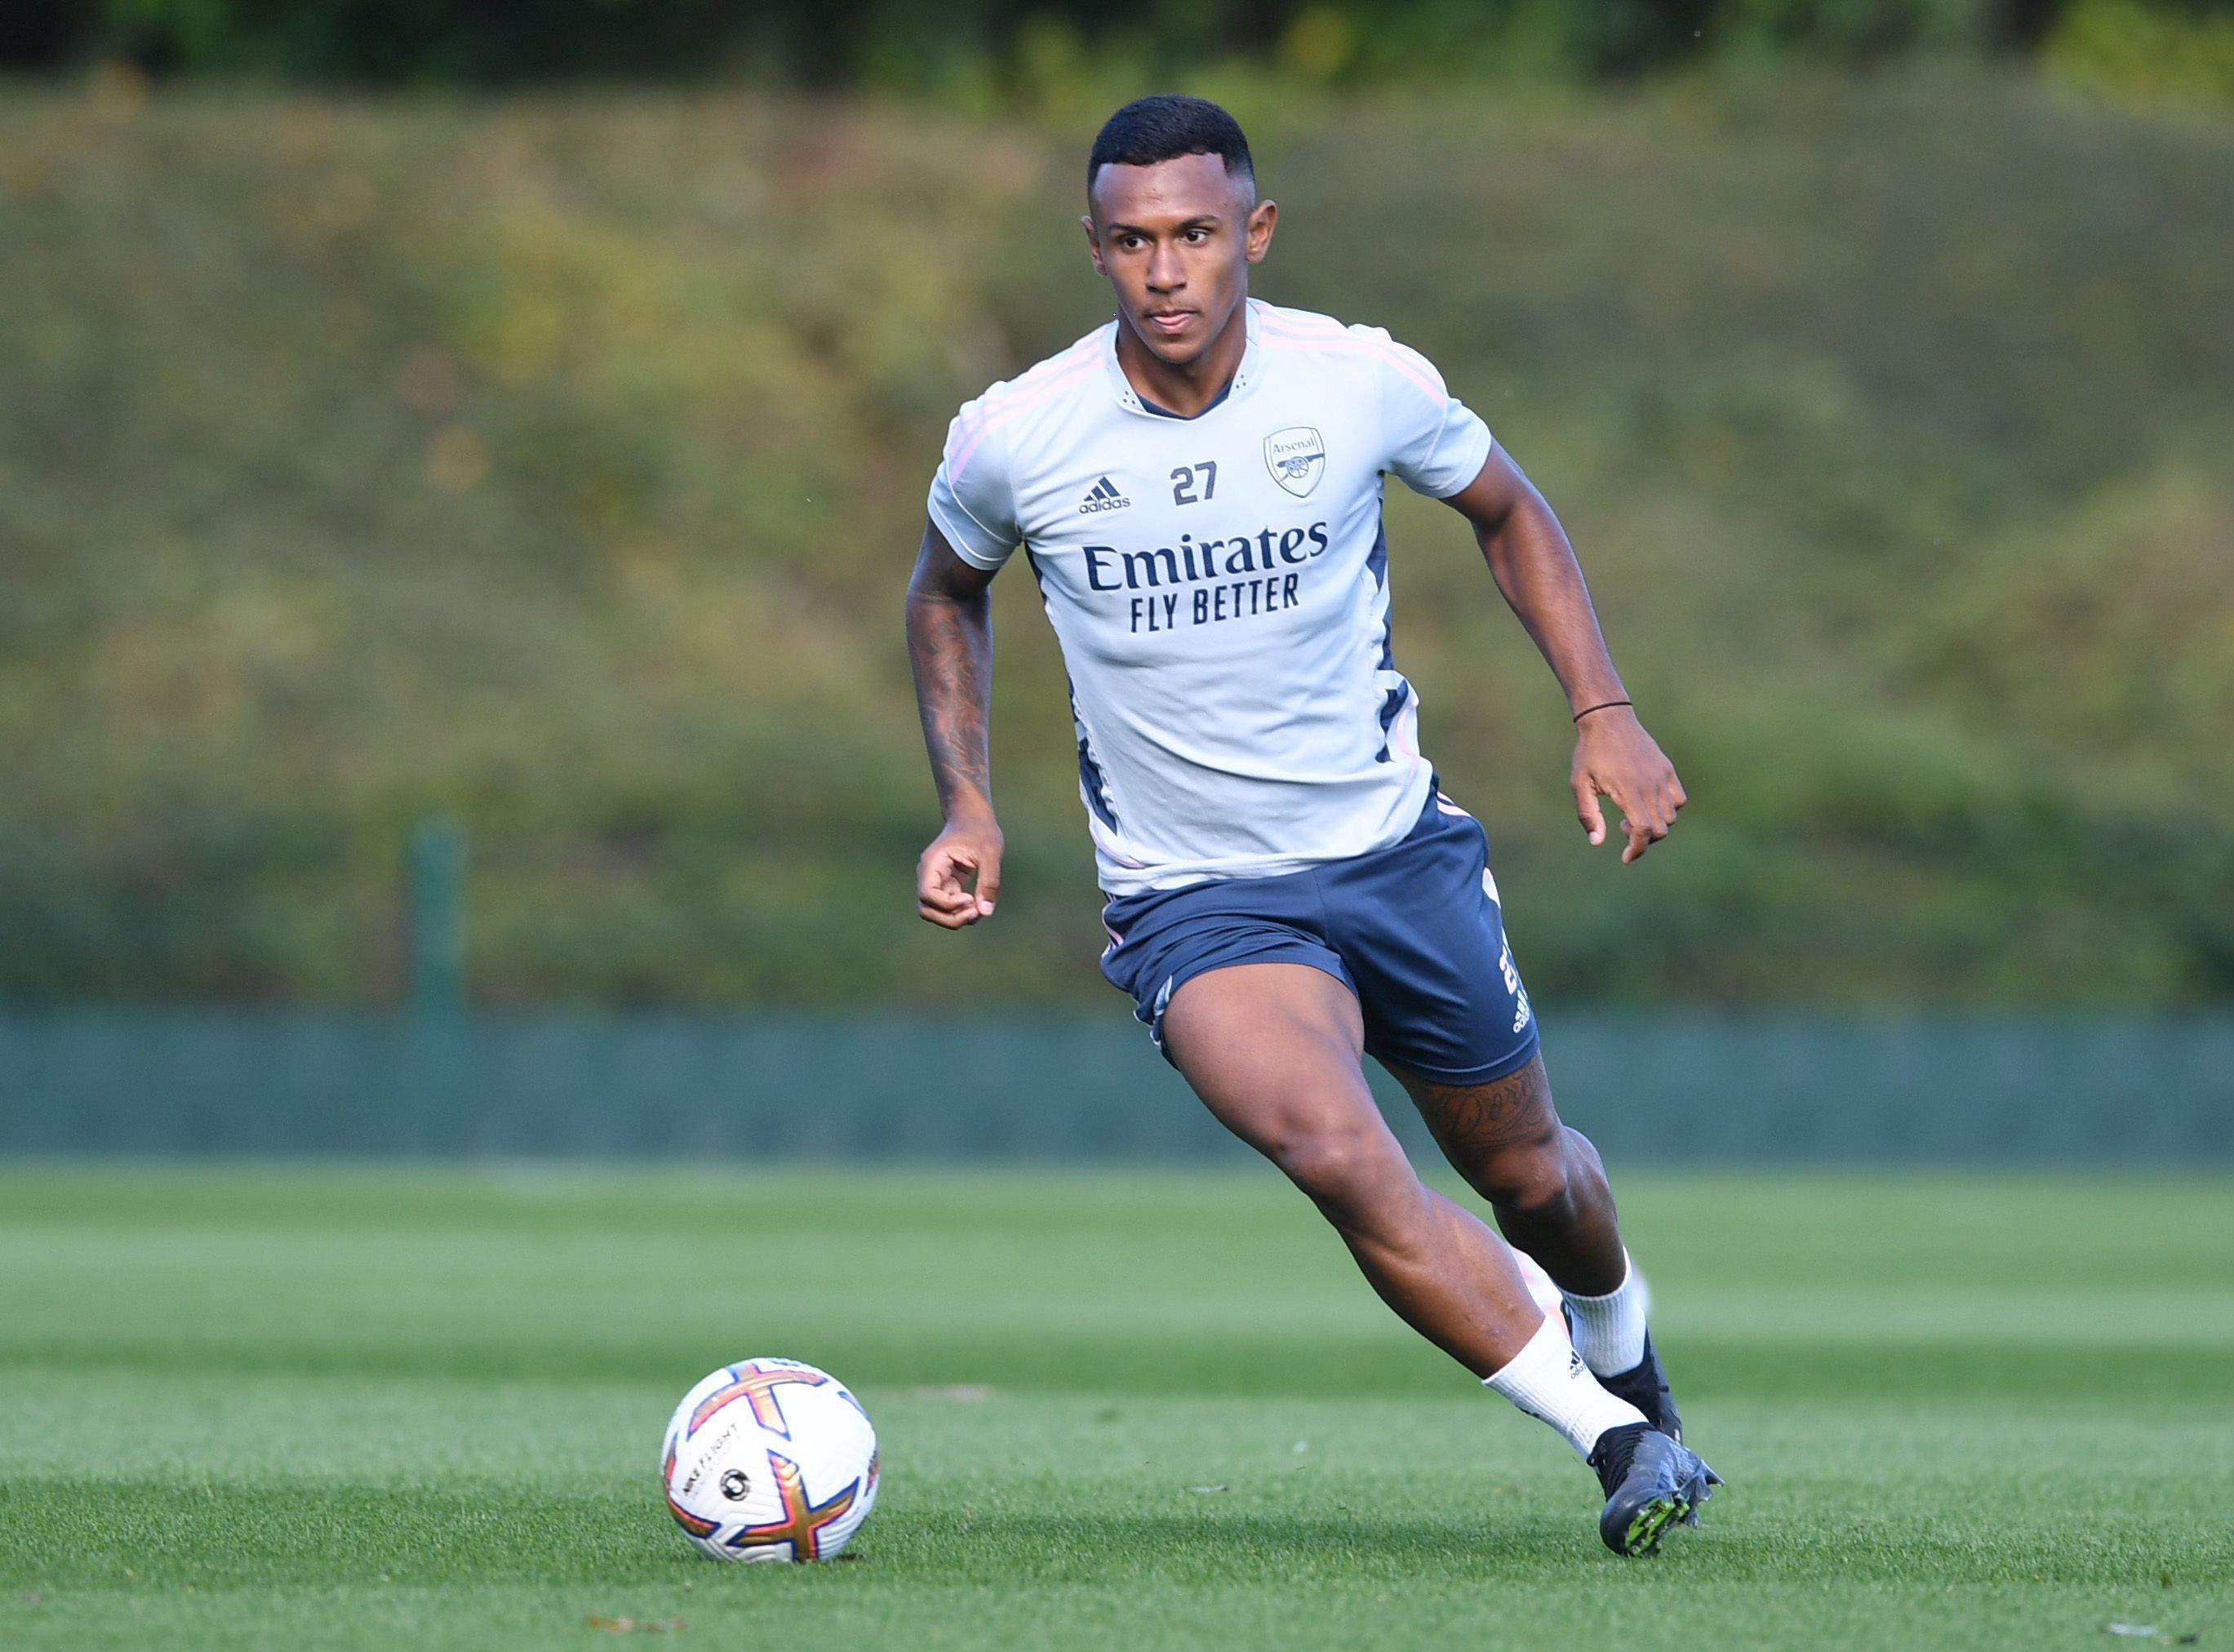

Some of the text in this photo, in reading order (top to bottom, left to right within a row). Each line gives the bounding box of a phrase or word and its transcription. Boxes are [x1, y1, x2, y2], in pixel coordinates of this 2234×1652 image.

[1273, 437, 1315, 454] Arsenal
[1079, 496, 1131, 514] adidas
[1170, 460, 1218, 506] 27
[1082, 521, 1328, 591] Emirates
[1130, 572, 1299, 633] FLY BETTER
